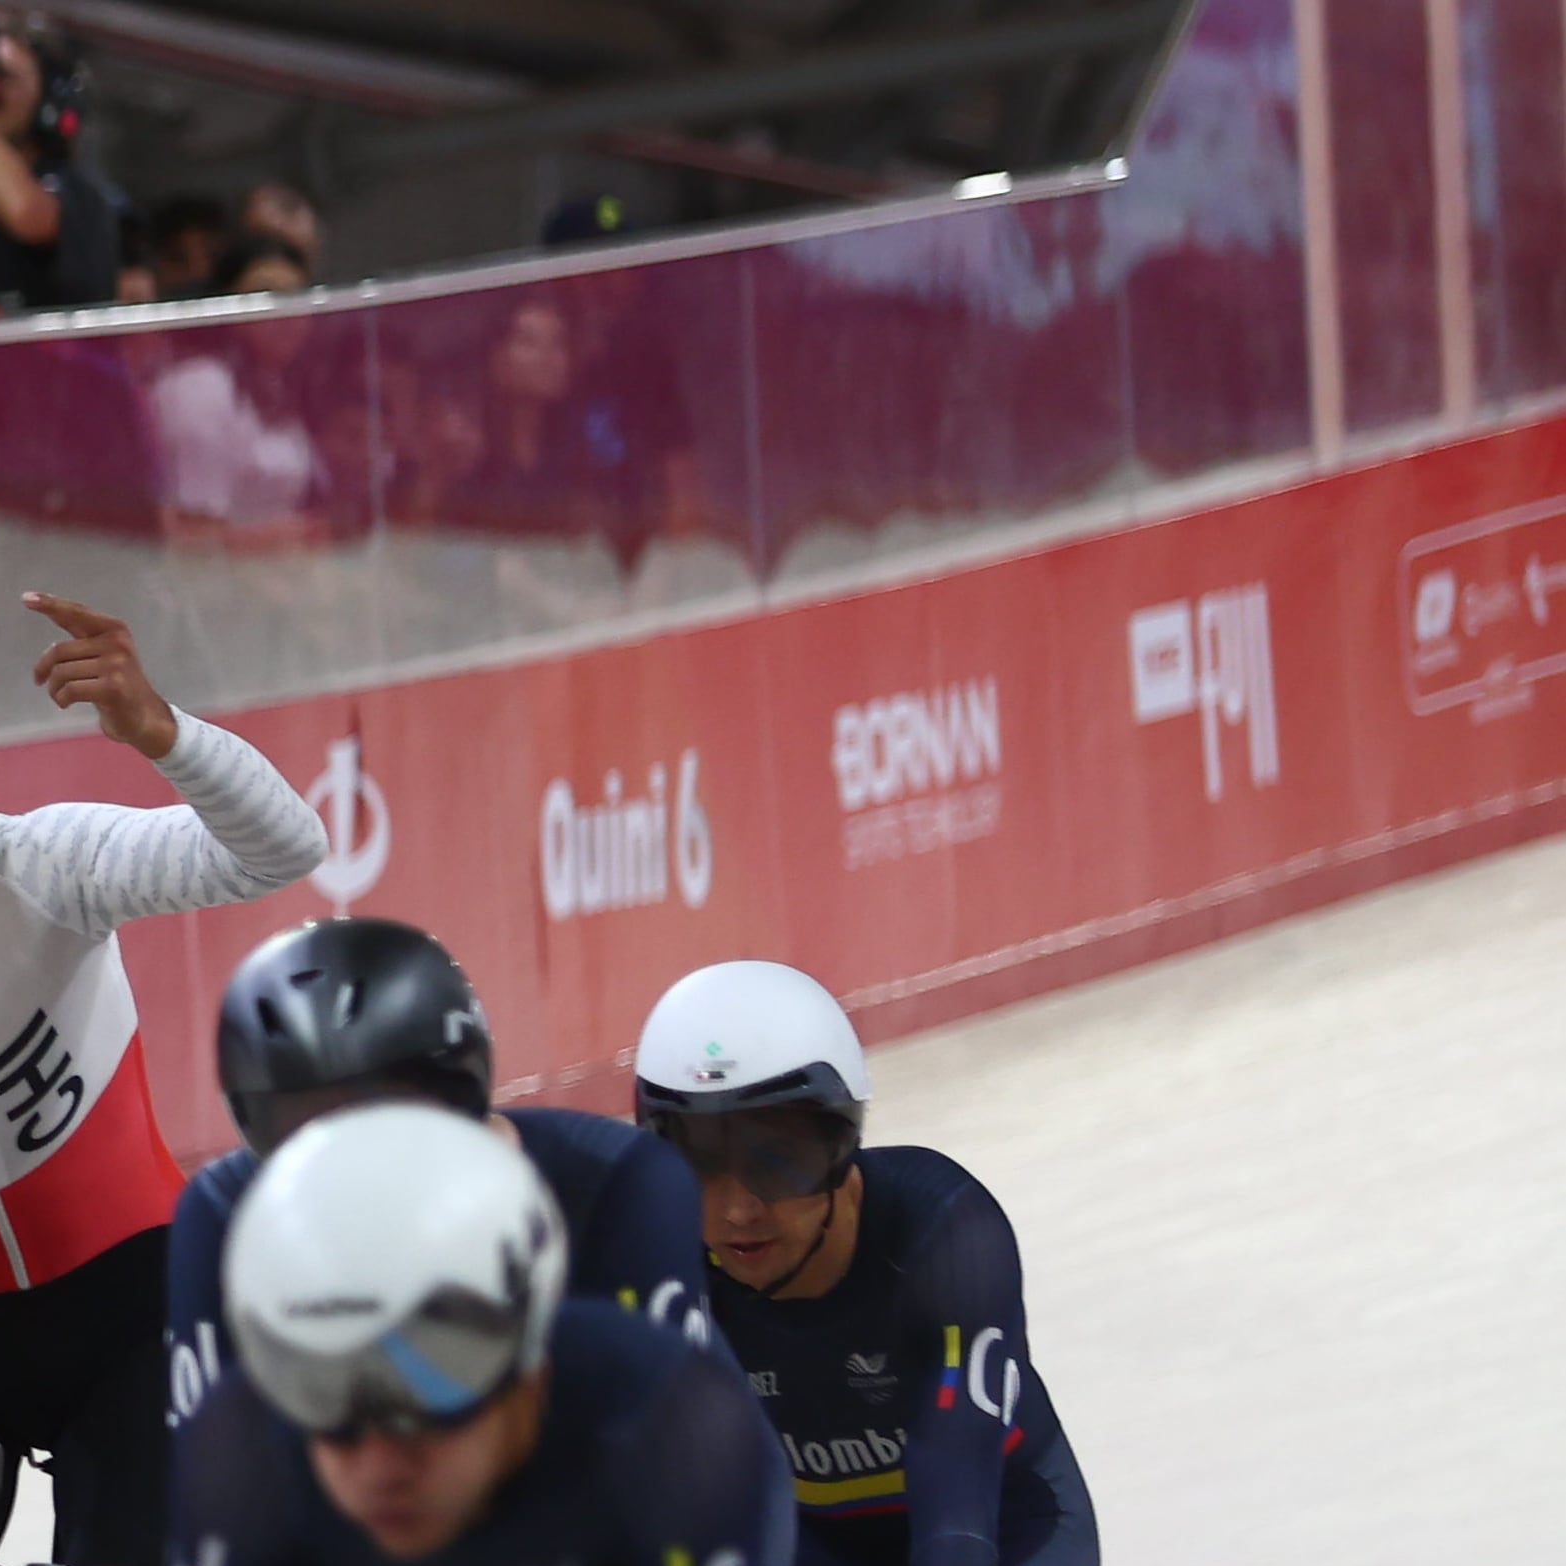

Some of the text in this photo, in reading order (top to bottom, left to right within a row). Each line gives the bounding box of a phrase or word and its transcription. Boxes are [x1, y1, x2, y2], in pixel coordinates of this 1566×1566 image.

[832, 673, 1001, 814] BORNAN
[541, 768, 668, 922] Quini
[677, 747, 713, 909] 6
[781, 1428, 907, 1476] lomb
